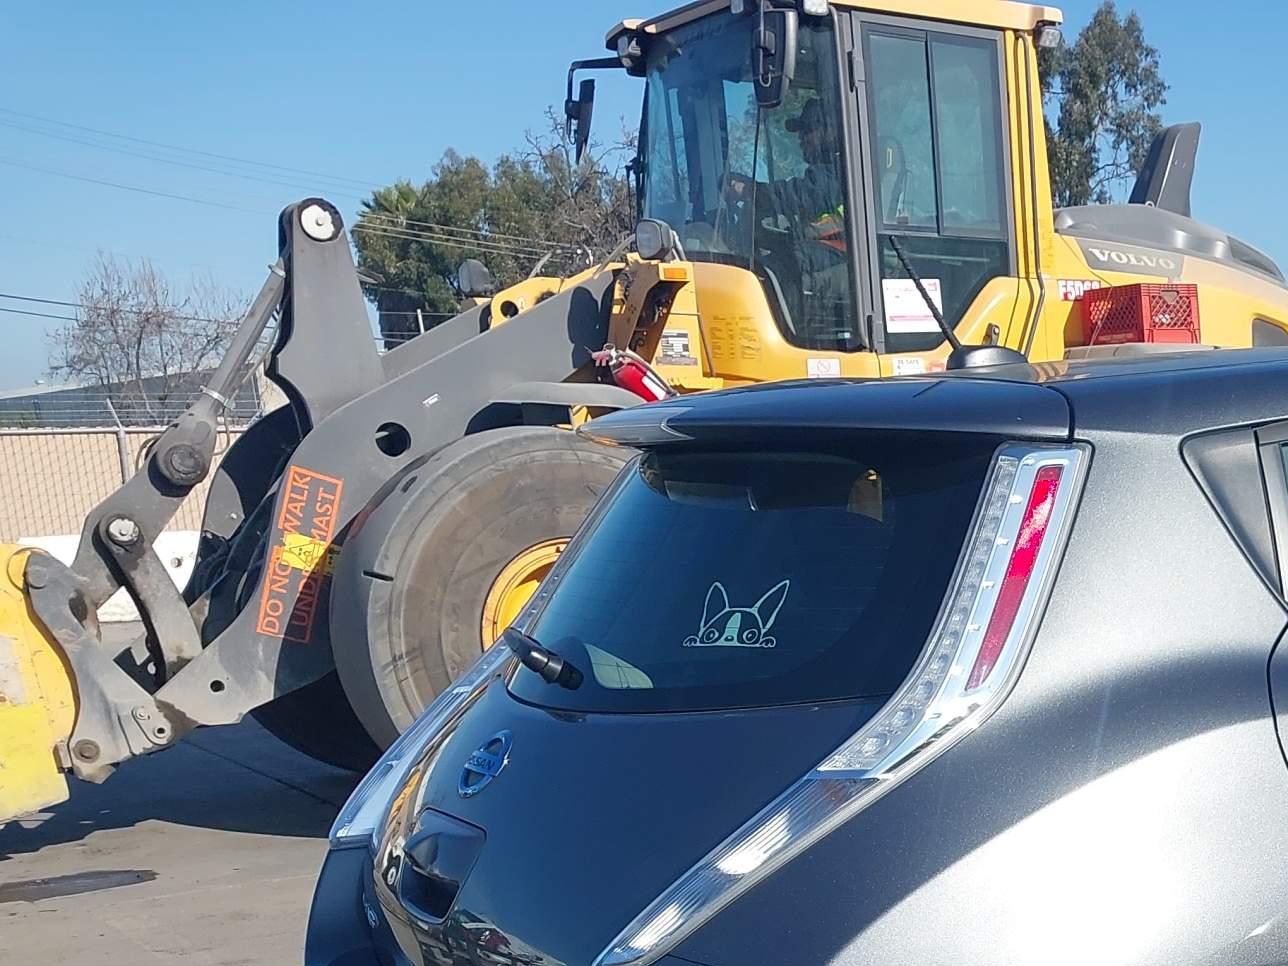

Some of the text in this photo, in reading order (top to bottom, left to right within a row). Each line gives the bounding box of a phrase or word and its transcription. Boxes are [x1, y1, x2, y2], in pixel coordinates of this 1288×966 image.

[1088, 248, 1176, 270] VOLVO
[311, 488, 335, 545] MAST
[262, 472, 312, 633] DO NO WALK
